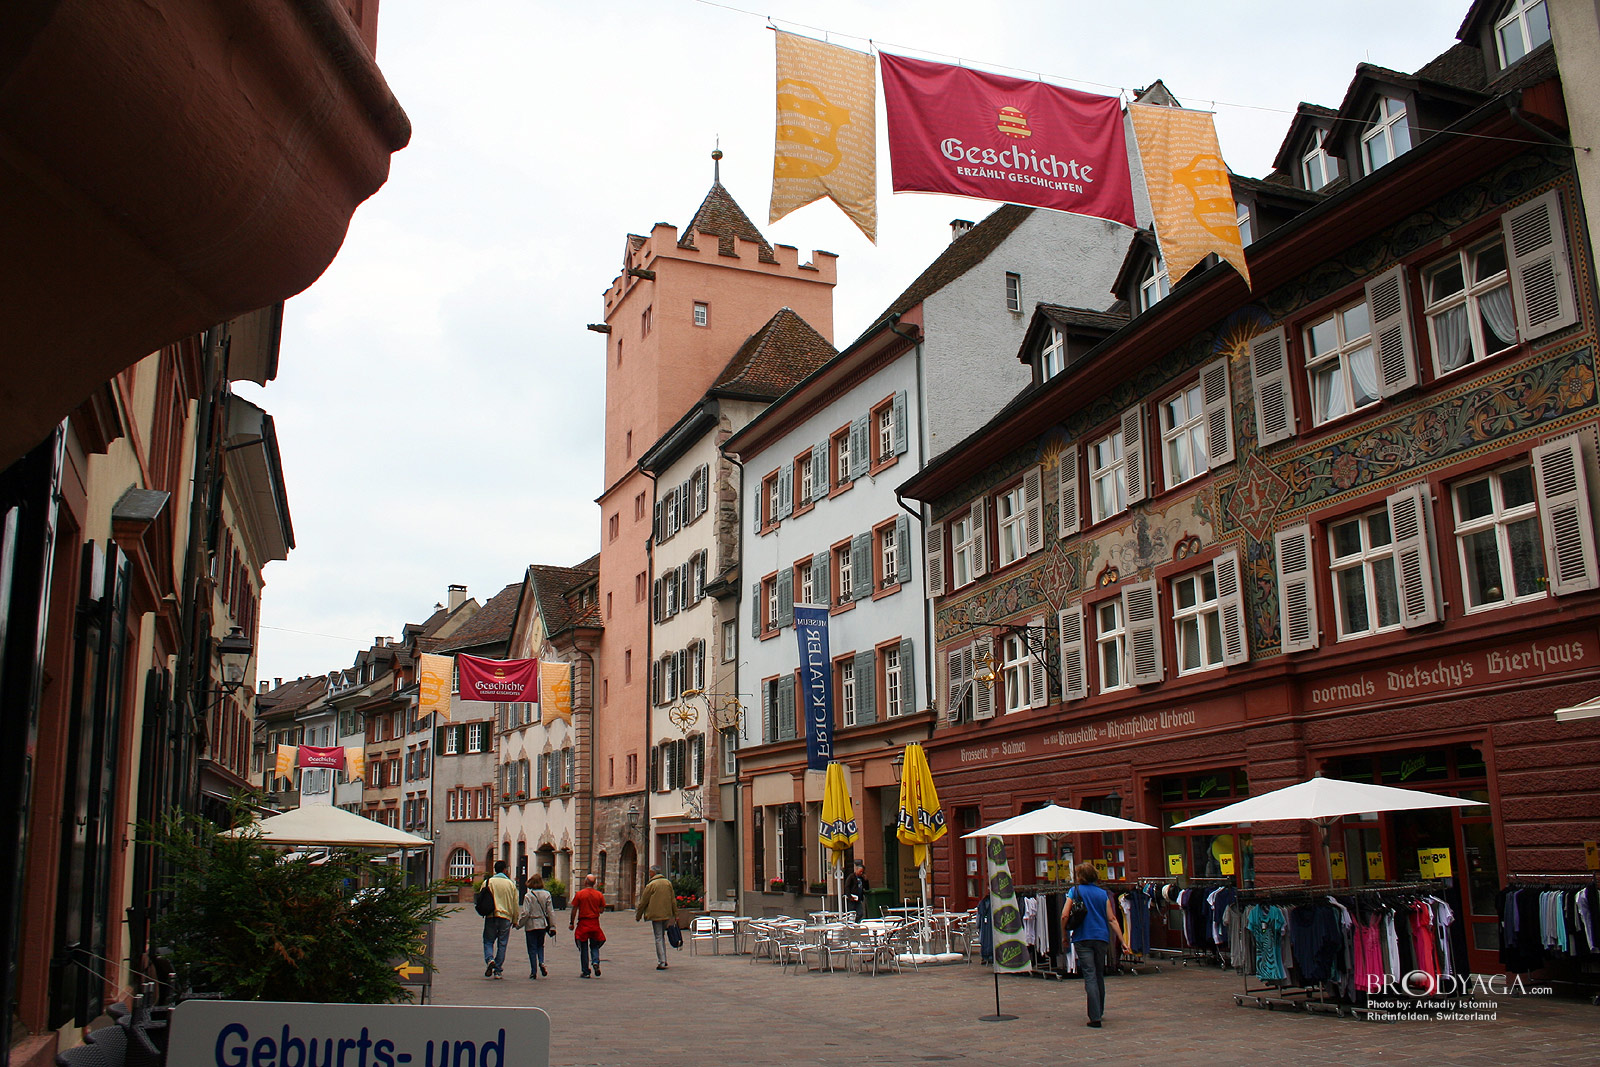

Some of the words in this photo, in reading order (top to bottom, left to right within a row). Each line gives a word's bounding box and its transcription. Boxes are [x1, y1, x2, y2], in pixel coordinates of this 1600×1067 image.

[940, 138, 1094, 183] Geschichte
[956, 166, 1006, 180] ERZÄHLT
[1008, 173, 1083, 194] GESCHICHTEN
[475, 680, 525, 691] Geschichte
[1311, 675, 1376, 703] vormals
[1387, 660, 1474, 691] Dietschy's
[1487, 641, 1584, 674] Bierhaus
[1107, 715, 1159, 740] Rheinfelder
[215, 1023, 412, 1067] Geburts-
[425, 1028, 506, 1067] und
